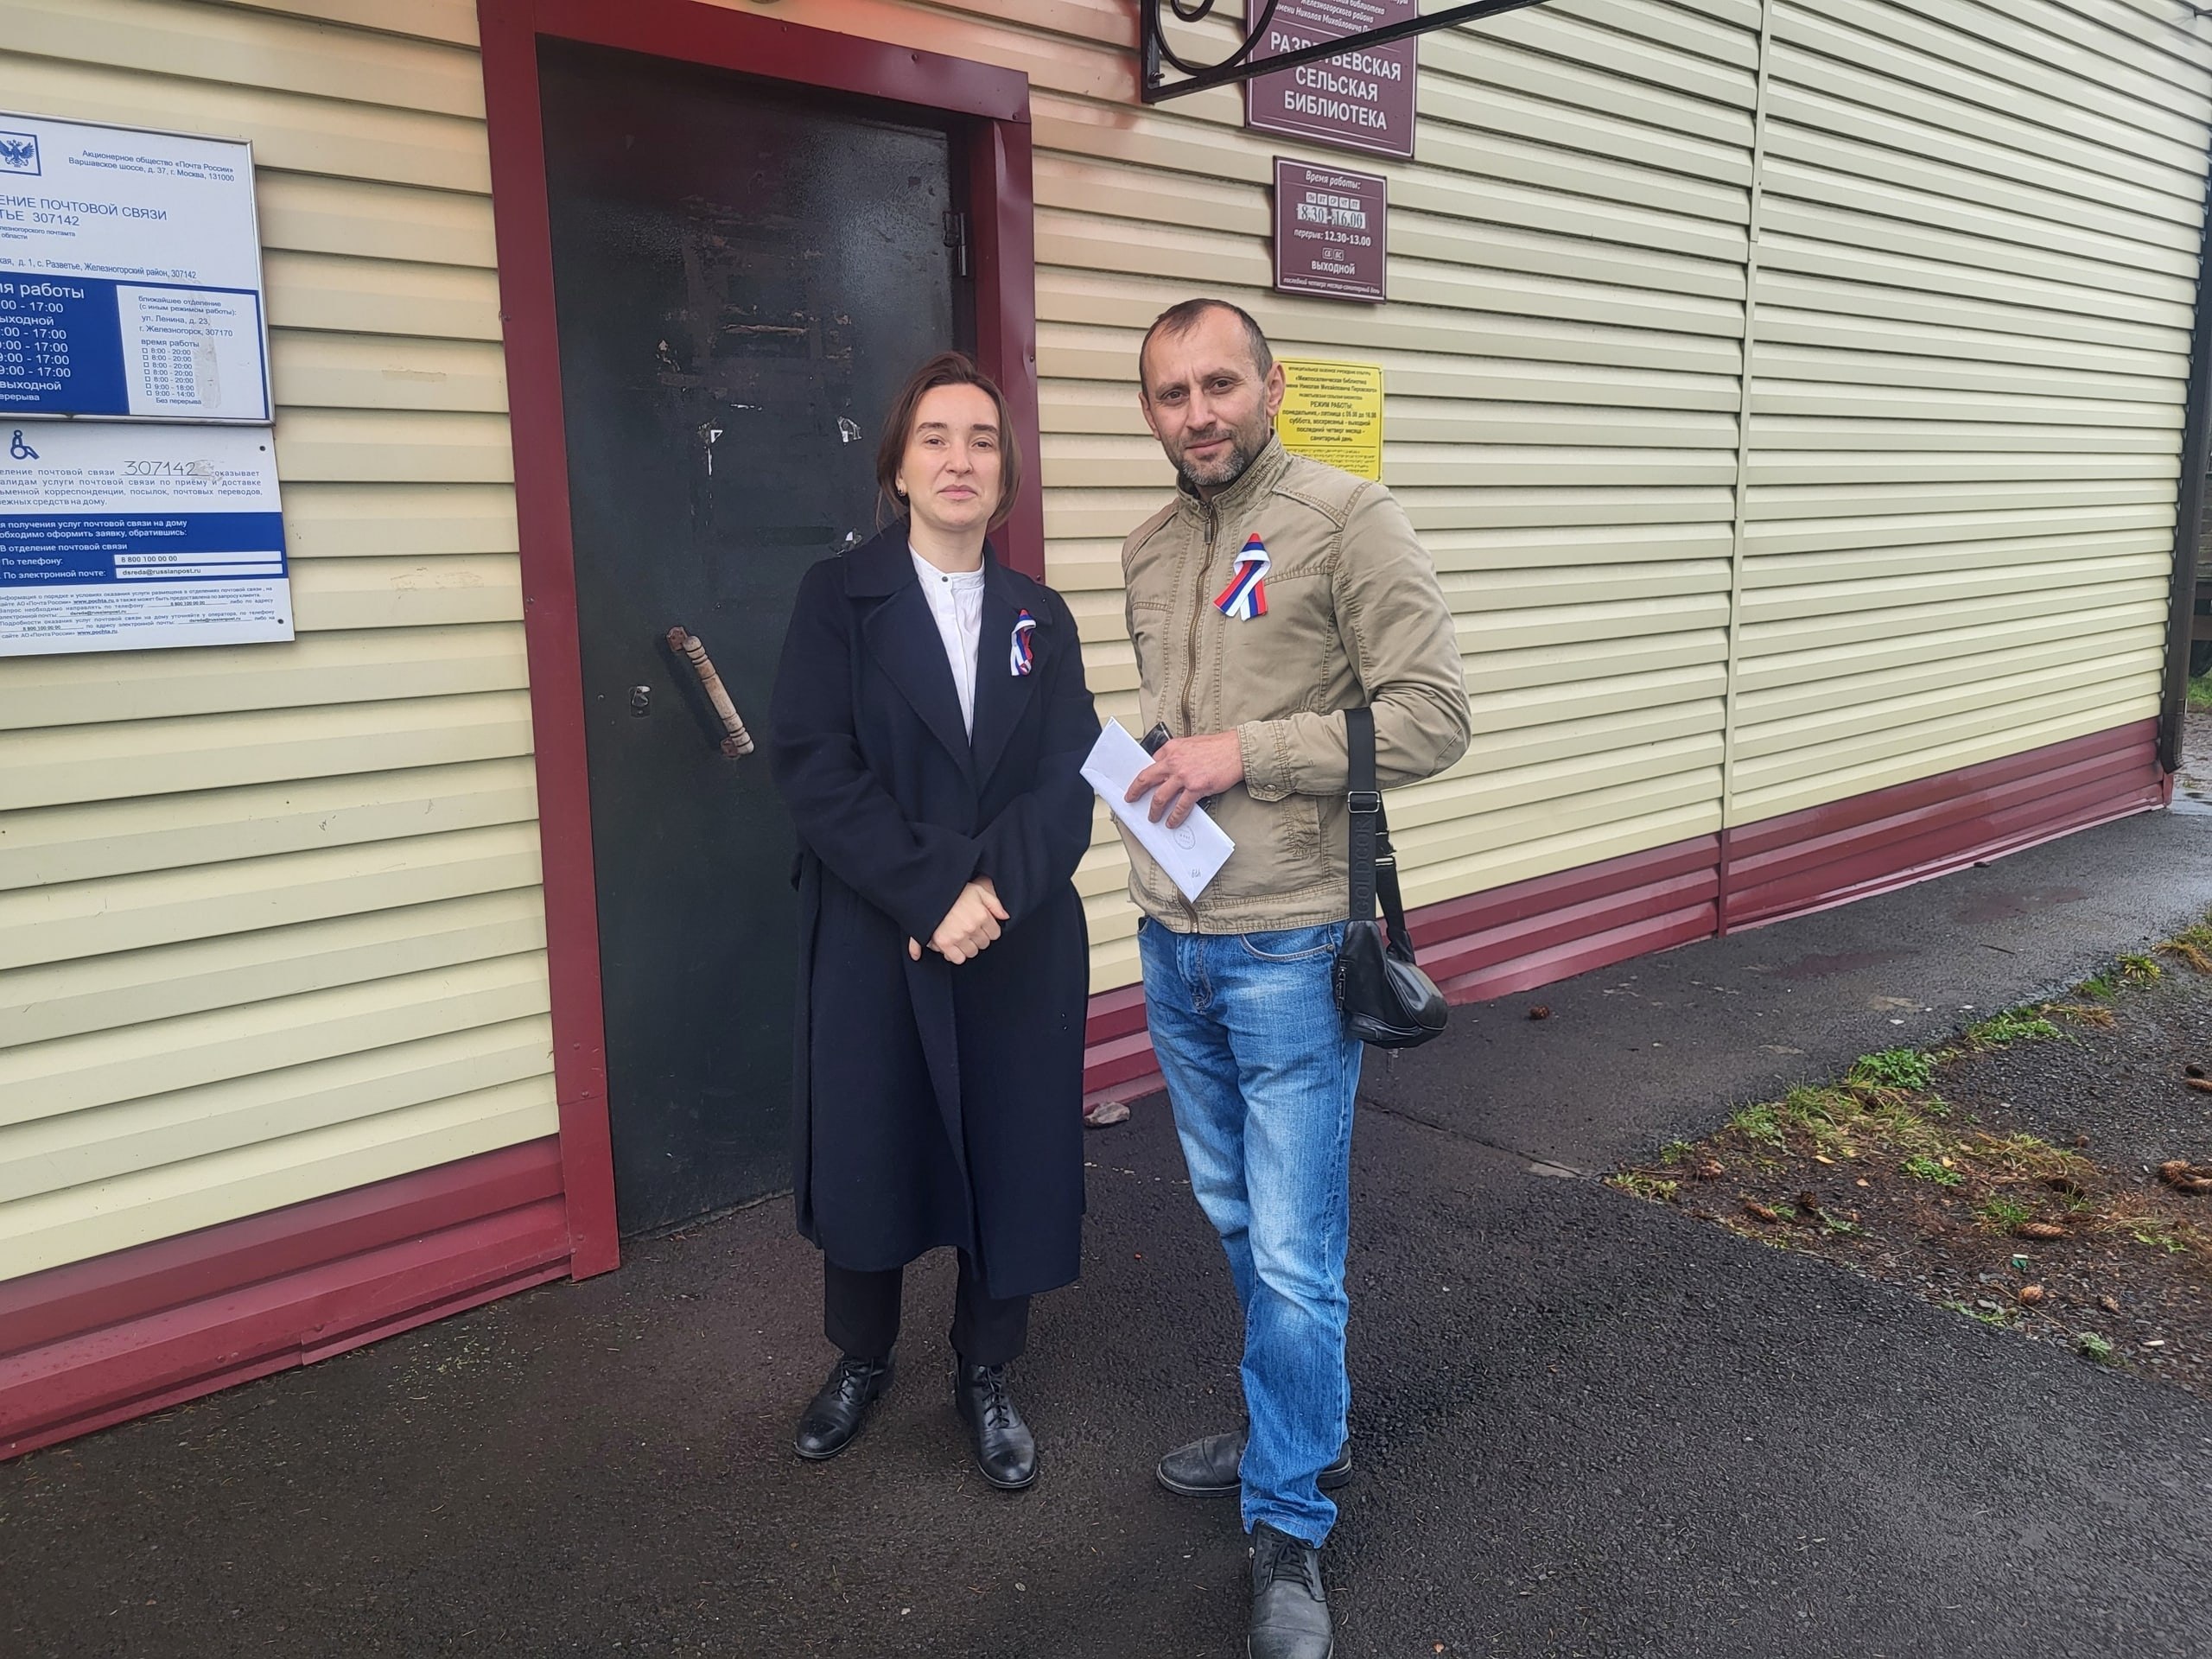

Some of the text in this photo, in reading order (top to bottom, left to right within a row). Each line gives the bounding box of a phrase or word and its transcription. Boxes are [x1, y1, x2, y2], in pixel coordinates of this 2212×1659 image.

[1296, 7, 1321, 22] Николая
[1296, 67, 1377, 102] СЕЛЬСКАЯ
[1285, 91, 1387, 130] БИБЛИОТЕКА
[83, 149, 133, 162] Акционерное
[136, 156, 173, 167] общество
[69, 157, 117, 169] Варшавское
[119, 164, 146, 173] шоссе,
[177, 170, 207, 180] Москва,
[209, 173, 234, 181] 131000
[1306, 170, 1361, 189] Время работы:
[41, 199, 118, 216] ПОЧТОВОЙ
[122, 207, 167, 220] СВЯЗИ
[33, 213, 79, 226] 307142
[171, 270, 197, 278] 307142
[20, 283, 85, 299] работы
[30, 302, 64, 313] 17:00
[33, 328, 67, 339] 17:00
[206, 328, 232, 337] 307170
[35, 342, 68, 353] 17:00
[36, 354, 69, 365] 17:00
[37, 367, 71, 378] 17:00
[0, 381, 61, 391] выходной
[38, 467, 83, 476] почтовой
[124, 461, 198, 476] 307142
[8, 521, 55, 530] получения
[84, 519, 124, 528] почтовой
[47, 531, 93, 539] оформить
[9, 544, 56, 553] отделение
[58, 543, 99, 551] почтовой
[16, 557, 63, 566] телефону:
[19, 570, 77, 580] электронной
